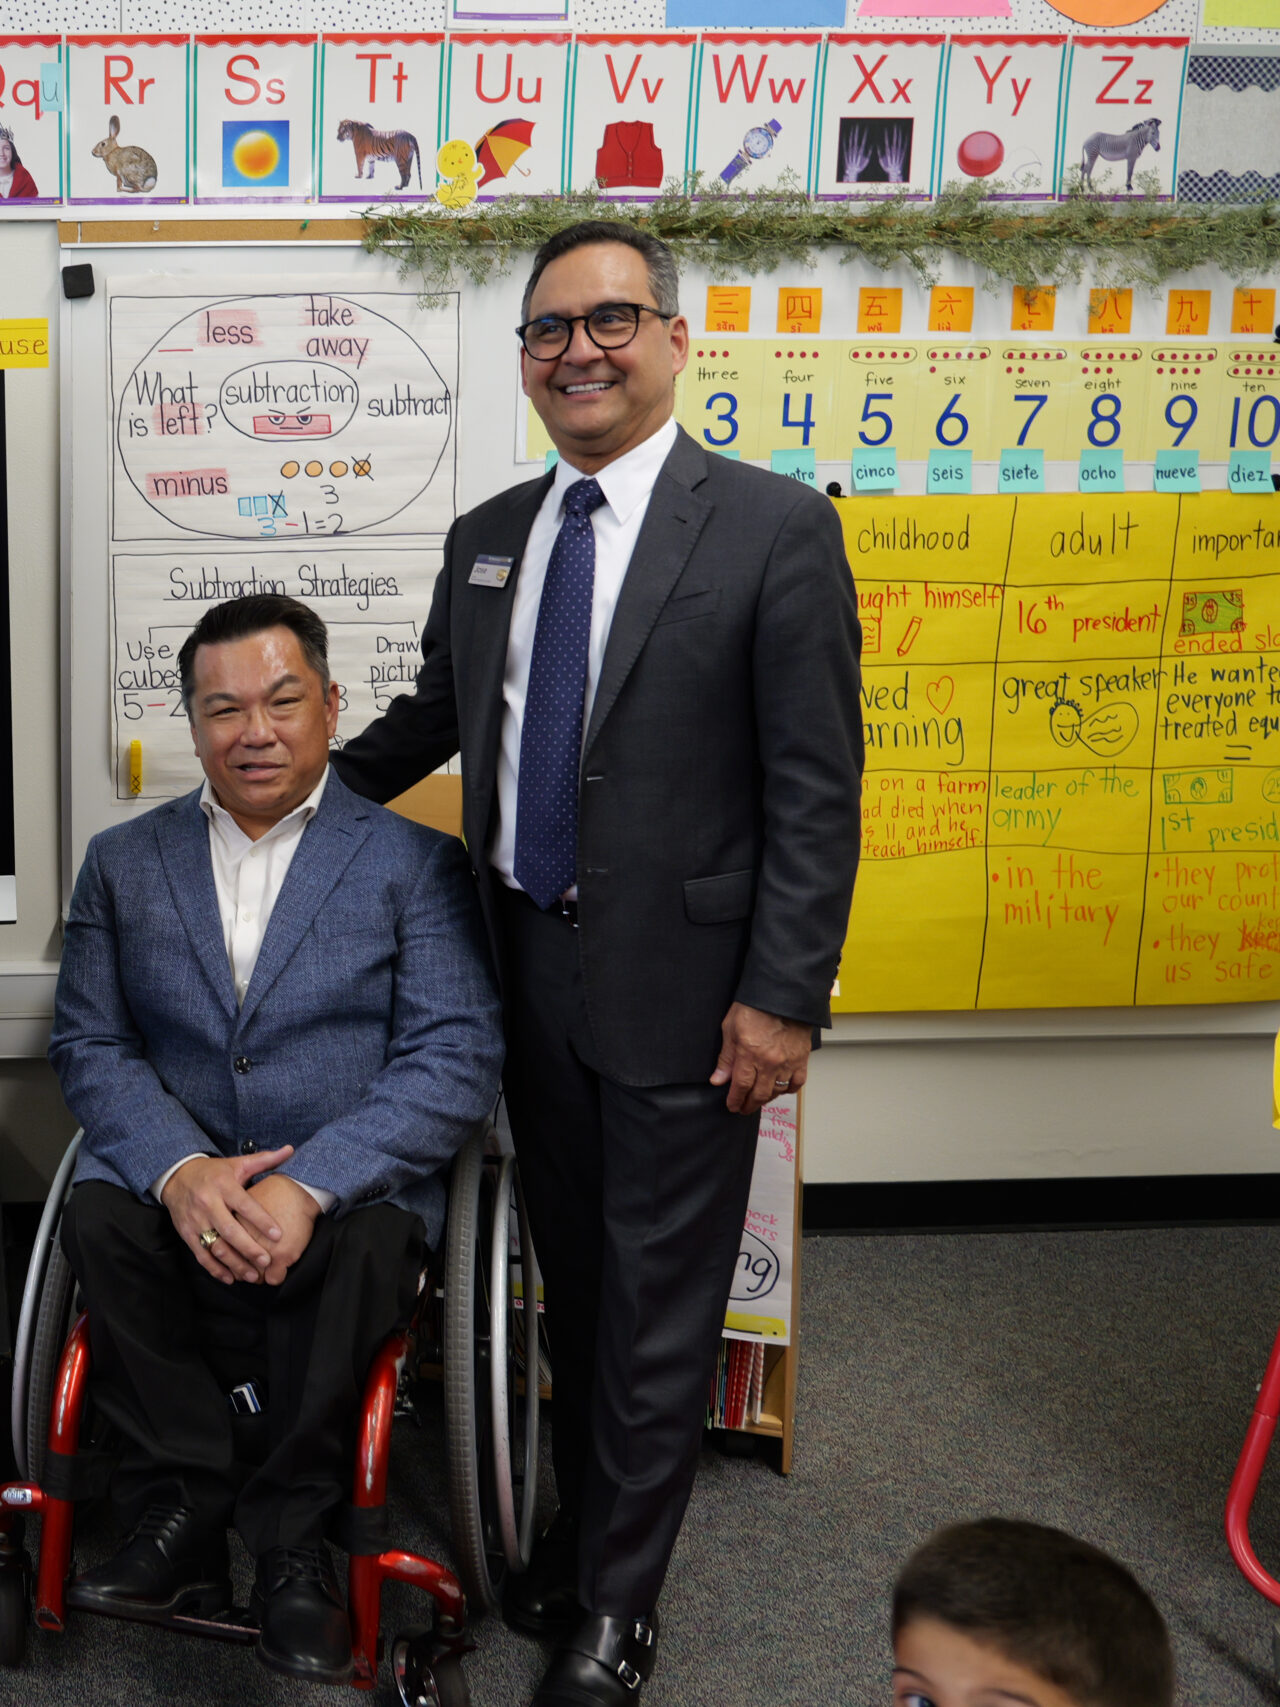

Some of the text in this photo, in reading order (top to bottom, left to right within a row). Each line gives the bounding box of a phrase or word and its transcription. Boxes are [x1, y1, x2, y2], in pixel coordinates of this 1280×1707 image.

[104, 55, 155, 105] Rr
[224, 54, 286, 105] Ss
[355, 53, 408, 103] Tt
[475, 53, 542, 104] Uu
[605, 54, 663, 104] Vv
[712, 53, 807, 104] Ww
[848, 53, 914, 104] Xx
[973, 54, 1032, 116] Yy
[1095, 56, 1154, 105] Zz
[305, 294, 354, 327] take
[713, 293, 739, 314] 三
[787, 295, 812, 320] 四
[864, 296, 889, 316] 五
[937, 292, 962, 316] 六
[1098, 296, 1122, 320] 八
[1177, 295, 1198, 322] 九
[1243, 293, 1262, 316] 十
[206, 311, 254, 345] less
[306, 337, 370, 370] away
[134, 371, 199, 408] What
[225, 369, 356, 405] subtraction
[697, 367, 740, 382] three
[783, 369, 815, 384] four
[865, 372, 894, 386] five
[944, 373, 966, 385] six
[1015, 378, 1051, 389] seven
[1084, 379, 1122, 392] eight
[1171, 380, 1198, 391] nine
[1243, 381, 1266, 393] ten
[368, 383, 452, 417] subtract
[129, 413, 149, 438] is
[703, 391, 739, 447] 3
[782, 393, 816, 447] 4
[858, 393, 894, 447] 5
[935, 393, 969, 447] 6
[1014, 394, 1049, 447] 7
[1087, 393, 1122, 448] 8
[1164, 394, 1198, 448] 9
[1229, 394, 1280, 448] 10
[153, 472, 229, 497] minus
[856, 466, 895, 480] cinco
[933, 465, 964, 481] seis
[1002, 464, 1039, 480] siete
[1081, 464, 1117, 480] ocho
[1156, 465, 1197, 480] nueve
[1231, 464, 1268, 483] diez
[320, 485, 339, 505] 3
[858, 513, 970, 554] childhood
[1051, 511, 1139, 558] adult
[1193, 519, 1280, 561] importa
[170, 563, 398, 611] Subtraction Strategies
[857, 581, 1004, 624] ught himself
[1073, 604, 1162, 643] president
[126, 640, 174, 661] Use
[377, 636, 420, 654] Draw
[1174, 631, 1243, 654] ended
[1174, 655, 1280, 687] He wante
[861, 671, 909, 711] ved
[1002, 665, 1167, 714] great speaker
[1166, 688, 1256, 718] everyone
[864, 714, 965, 767] arning
[1160, 710, 1237, 741] treated
[881, 770, 987, 794] on a farm
[995, 763, 1140, 801] leader of the
[891, 795, 983, 820] died when
[863, 827, 983, 858] teach himself.
[906, 818, 941, 841] and
[949, 816, 966, 833] he
[992, 808, 1062, 848] army
[1005, 852, 1103, 891] in the
[1163, 856, 1216, 896] they
[1162, 895, 1203, 914] our
[1168, 922, 1220, 960] they
[1165, 951, 1273, 984] us safe
[771, 1114, 797, 1131] from
[738, 1252, 773, 1293] ng
